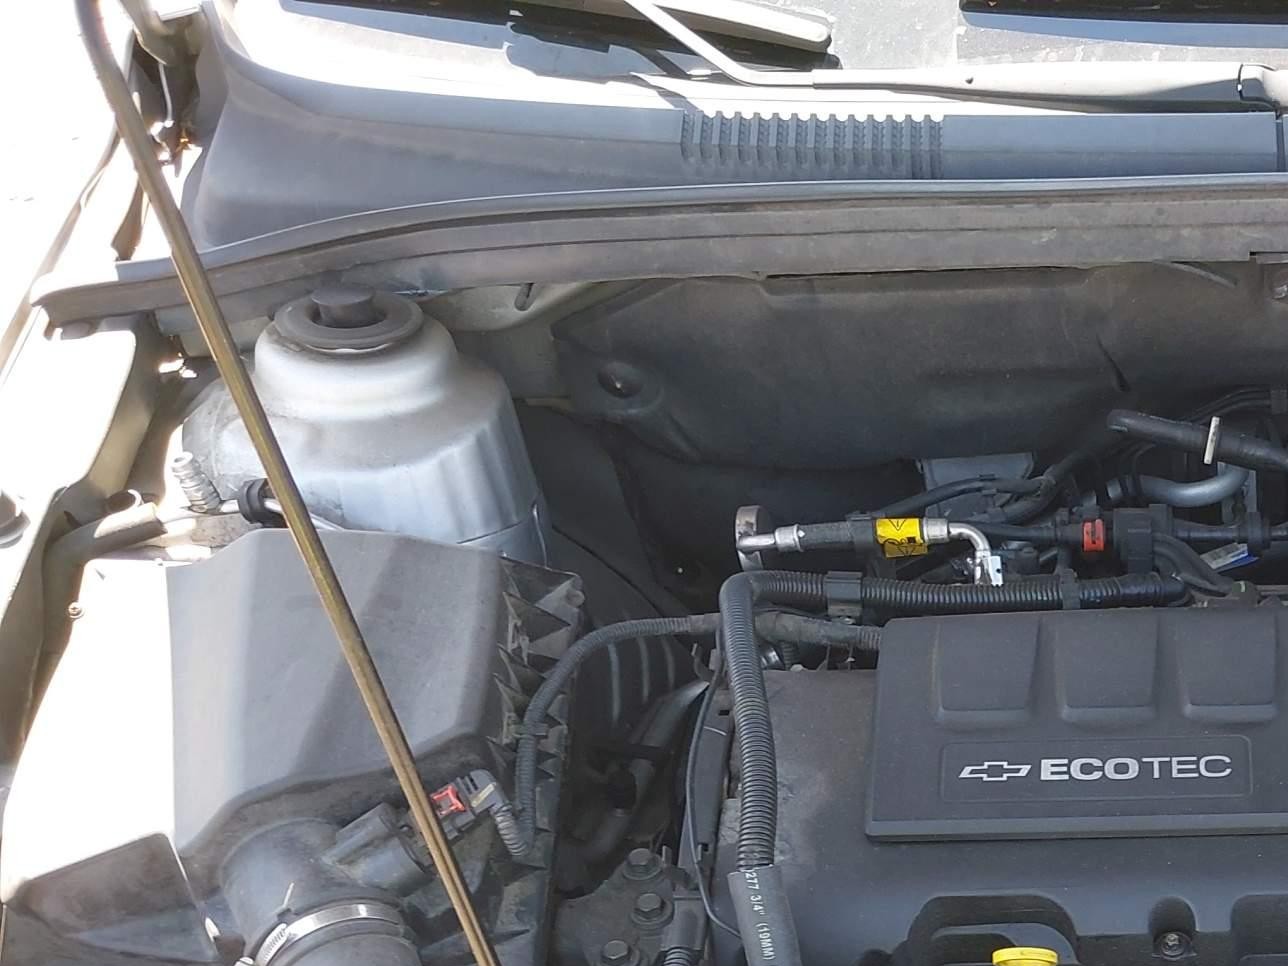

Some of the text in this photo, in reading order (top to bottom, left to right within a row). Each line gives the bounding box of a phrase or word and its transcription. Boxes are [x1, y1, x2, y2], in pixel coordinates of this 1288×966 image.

[1040, 755, 1232, 781] ECOTEC
[743, 869, 760, 890] 277
[750, 894, 766, 915] 3/4"
